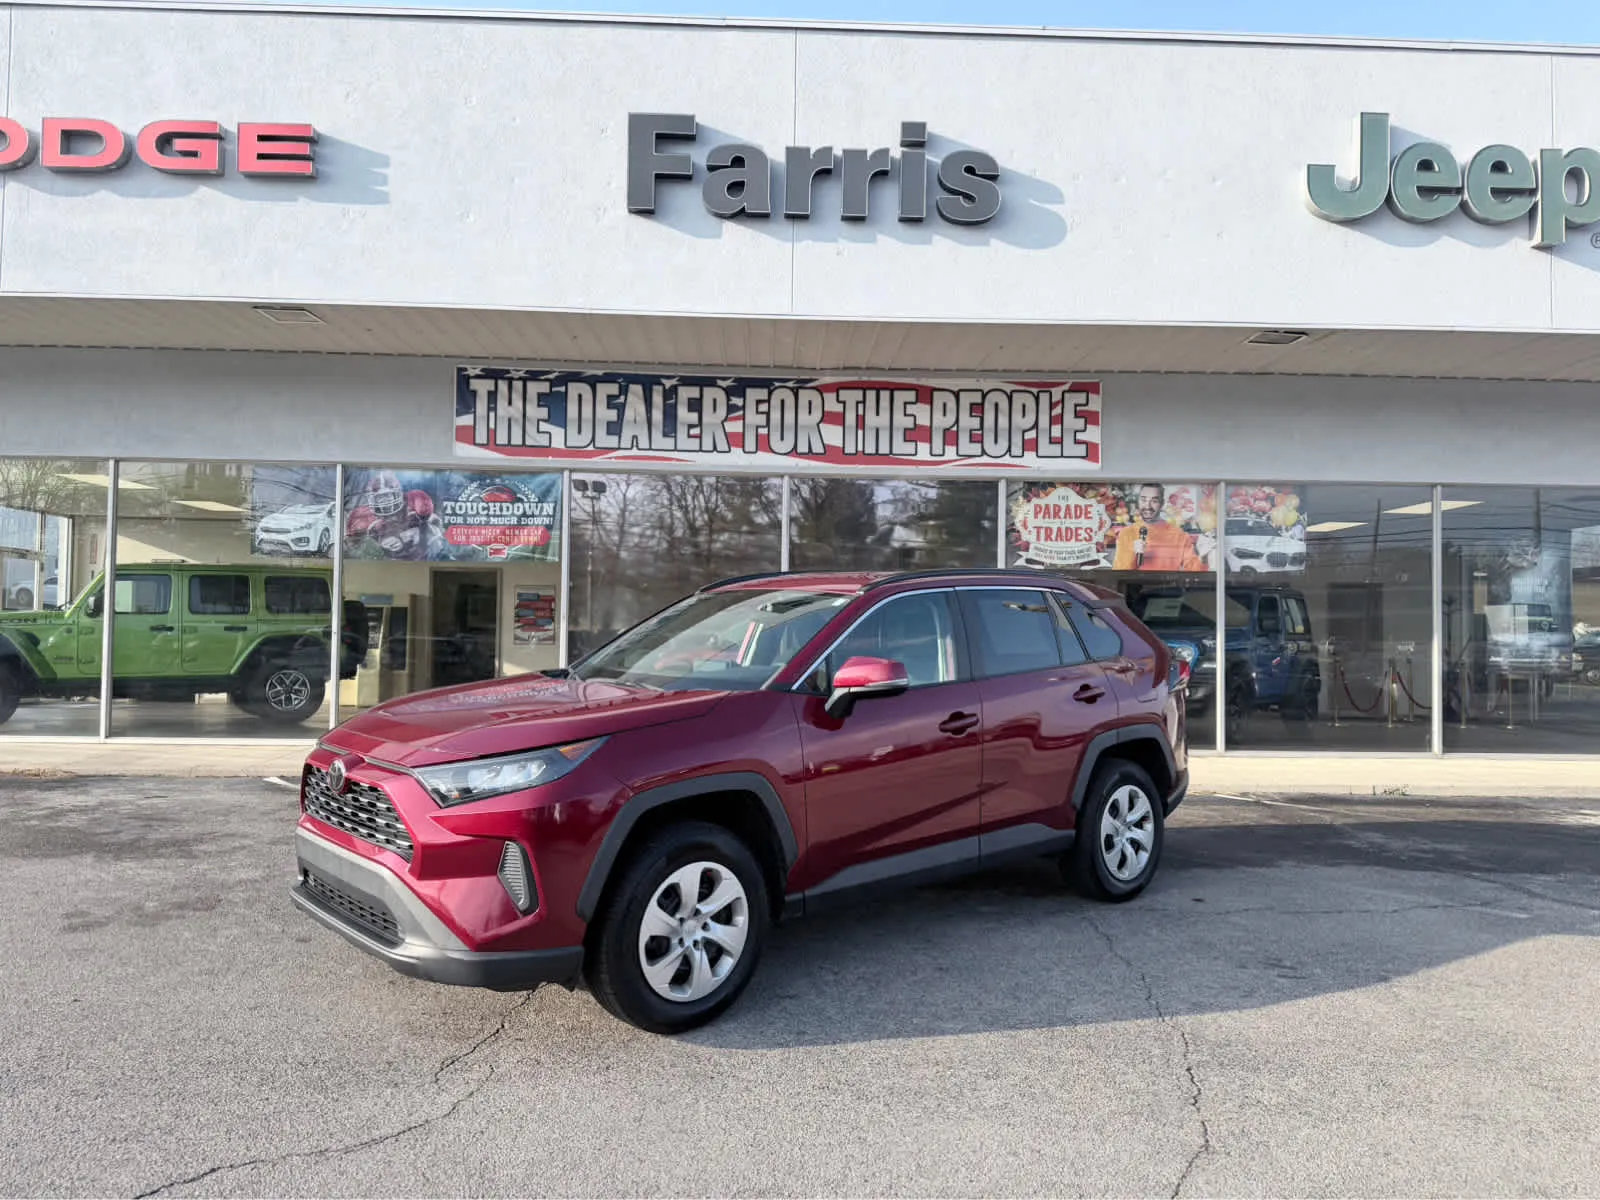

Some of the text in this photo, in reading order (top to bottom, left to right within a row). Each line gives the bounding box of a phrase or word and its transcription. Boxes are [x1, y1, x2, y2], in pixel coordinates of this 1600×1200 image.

[627, 112, 1001, 224] Farris
[1306, 112, 1600, 248] Jeep
[469, 378, 1089, 458] THE DEALER FOR THE PEOPLE
[443, 501, 555, 515] TOUCHDOWN
[1033, 503, 1094, 520] PARADE
[444, 516, 553, 525] FOR NOT MUCH DOWN!
[1032, 526, 1094, 542] TRADES
